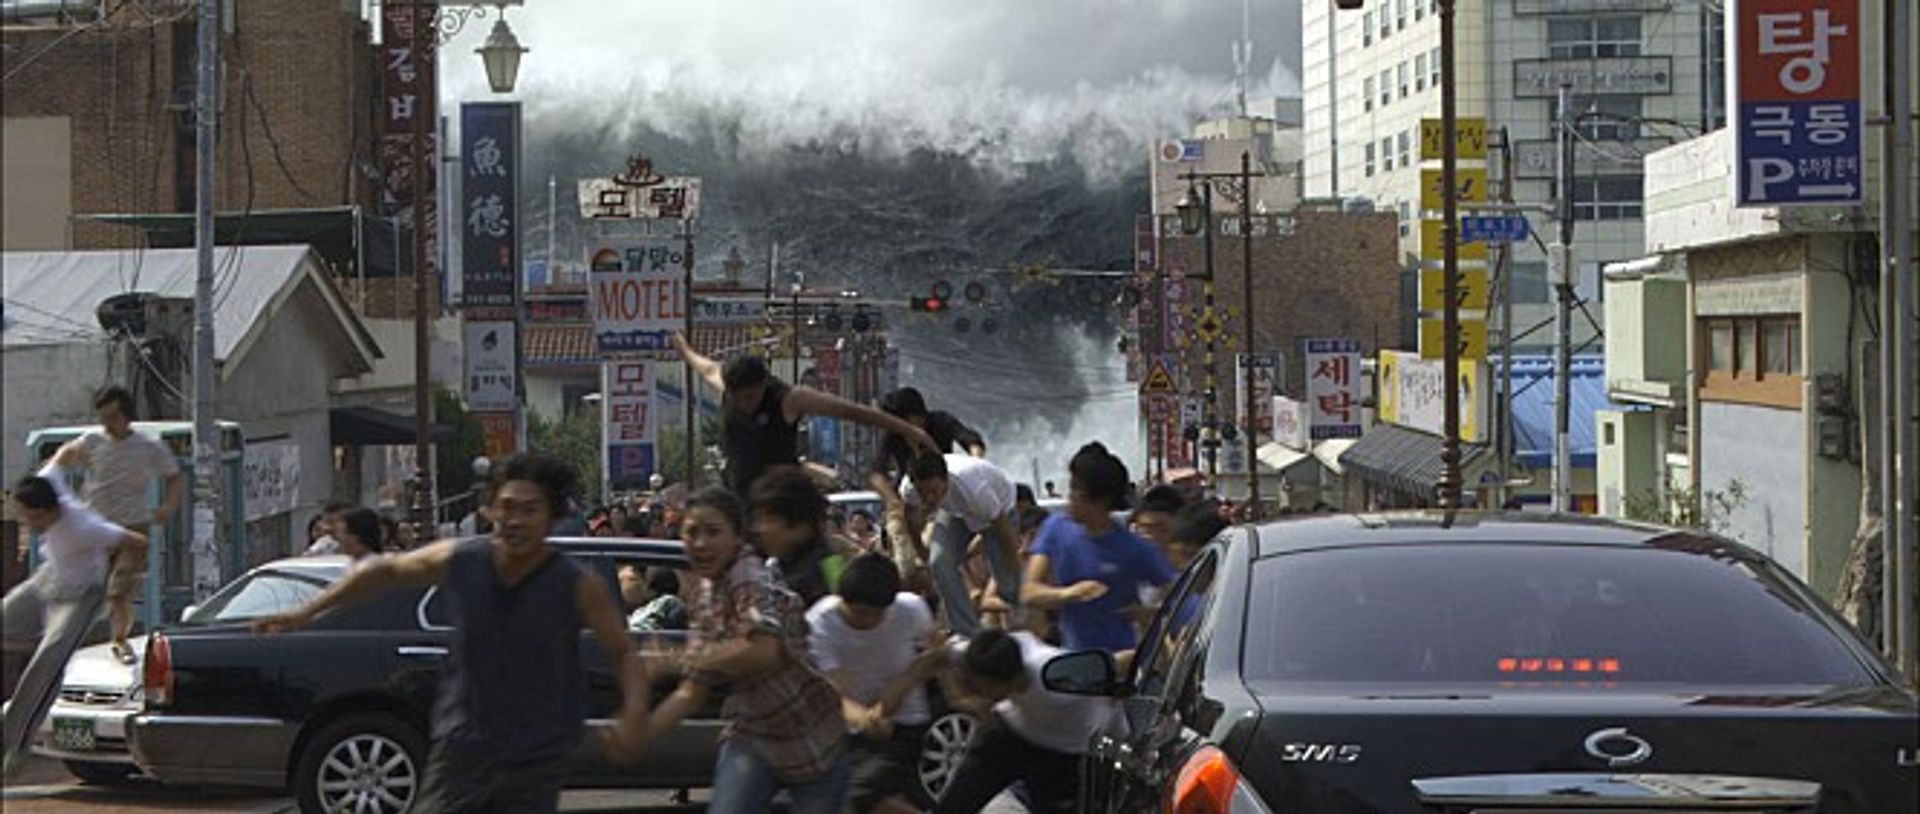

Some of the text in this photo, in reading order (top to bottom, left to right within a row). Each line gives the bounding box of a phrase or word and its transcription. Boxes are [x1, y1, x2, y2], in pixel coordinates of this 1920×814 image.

[1758, 9, 1847, 93] 탕
[1751, 105, 1849, 145] 극동
[1748, 158, 1794, 200] P
[1799, 158, 1832, 179] 주차장
[594, 188, 685, 218] 모텔
[598, 279, 684, 320] MOTEL
[612, 364, 647, 439] 모텔
[1311, 355, 1358, 422] 세탁
[1281, 743, 1361, 761] SM5
